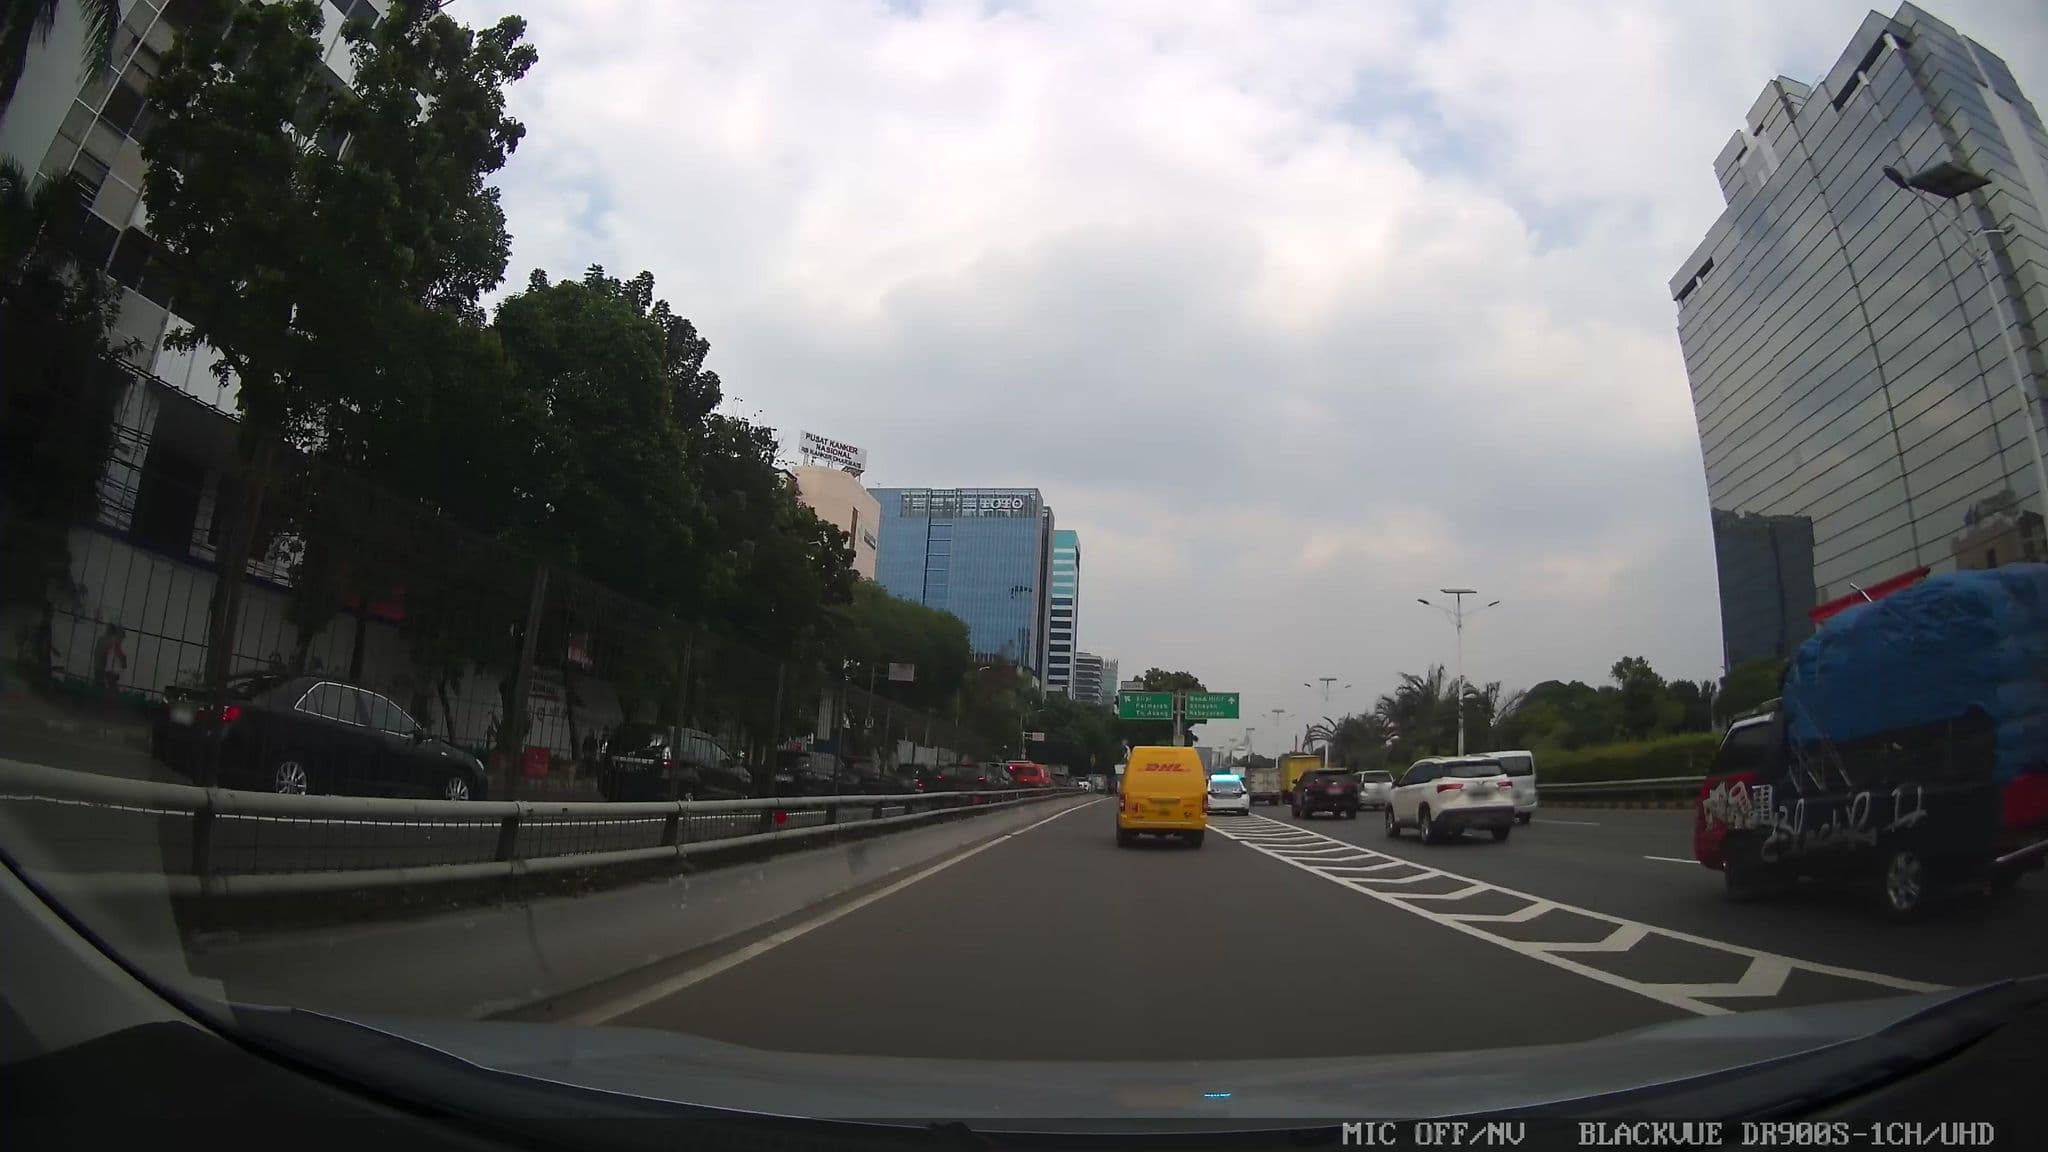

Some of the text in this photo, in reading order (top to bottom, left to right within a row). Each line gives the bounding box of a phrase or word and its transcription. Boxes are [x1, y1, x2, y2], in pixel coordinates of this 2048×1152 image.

[805, 432, 858, 455] PUSAT KANKER
[815, 444, 852, 460] NASIONAL
[1145, 763, 1184, 772] DHL
